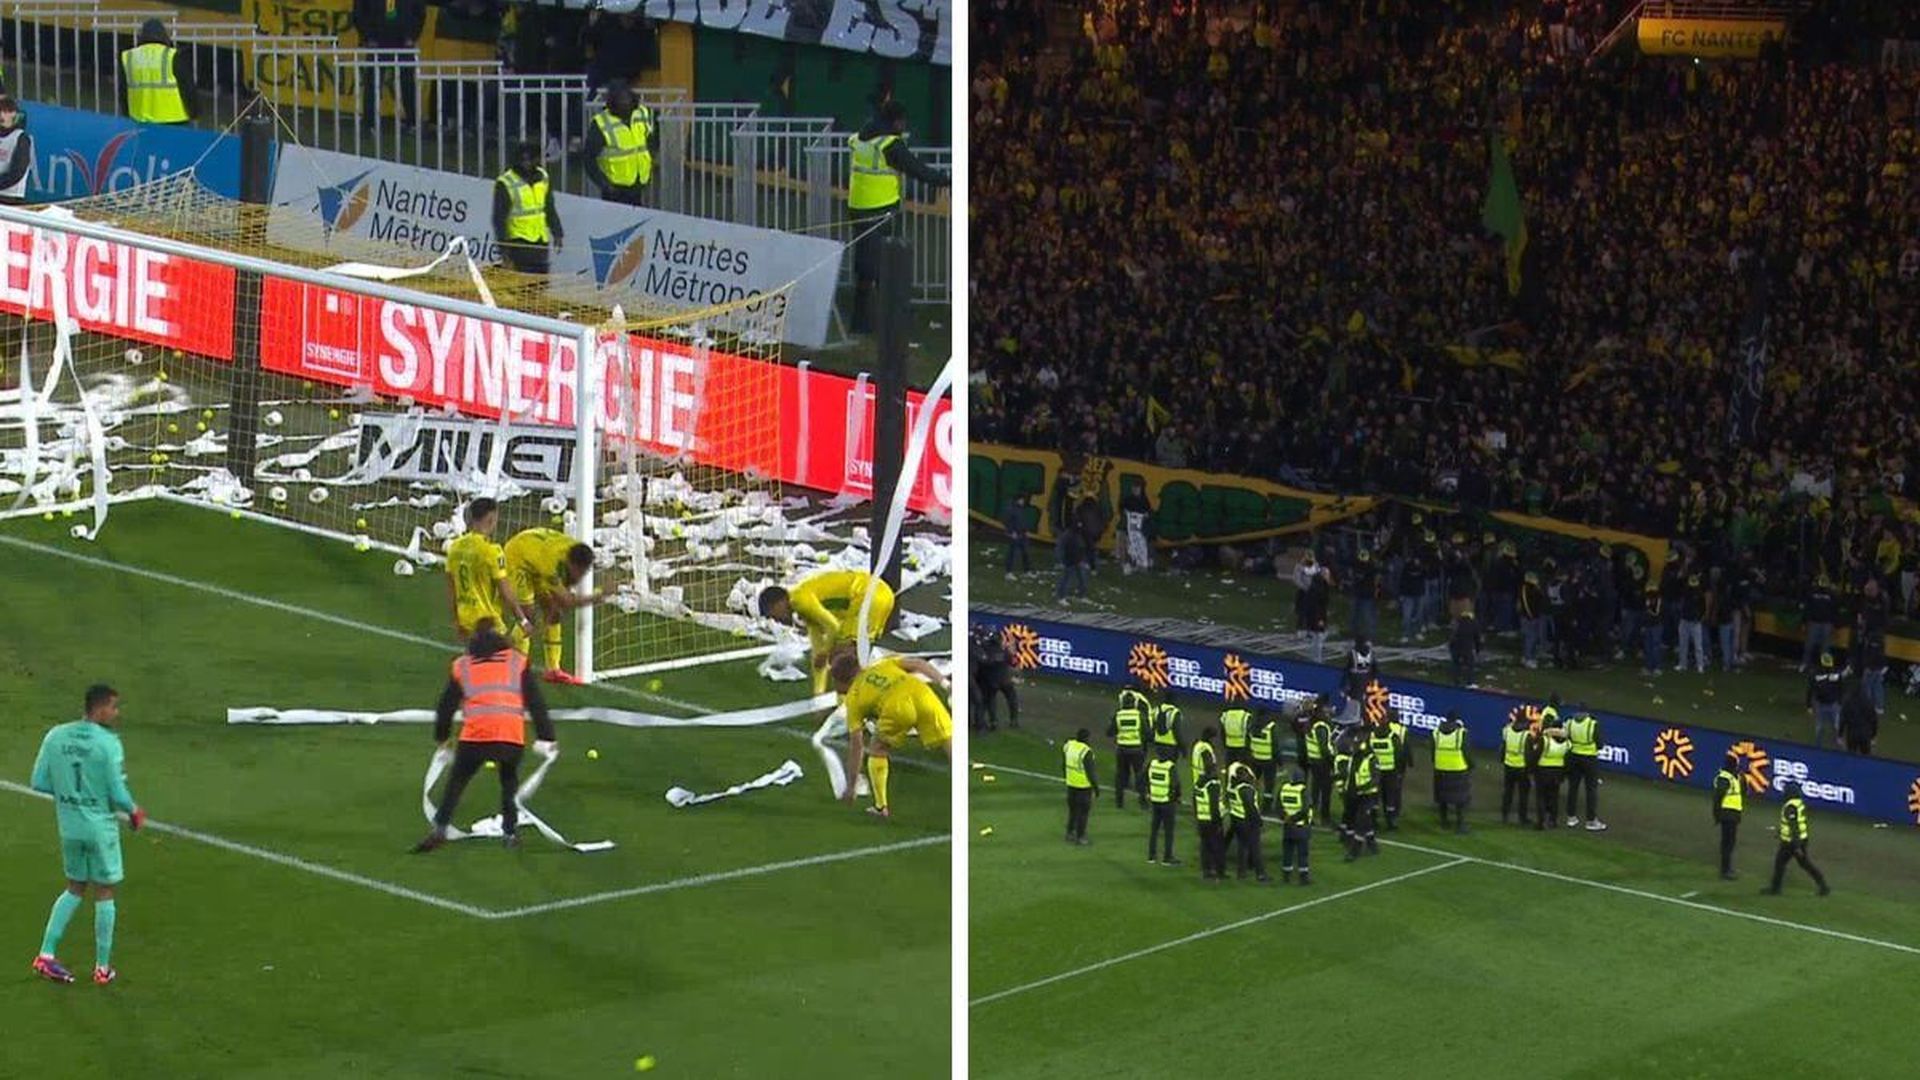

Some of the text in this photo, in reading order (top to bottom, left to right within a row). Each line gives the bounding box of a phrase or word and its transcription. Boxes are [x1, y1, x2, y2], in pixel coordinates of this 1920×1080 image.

[1662, 30, 1767, 48] FC NANTE
[376, 179, 468, 223] Nantes
[652, 229, 749, 275] Nantes
[380, 301, 698, 448] SYNERGIE
[72, 762, 82, 792] 1
[1773, 758, 1809, 779] Be
